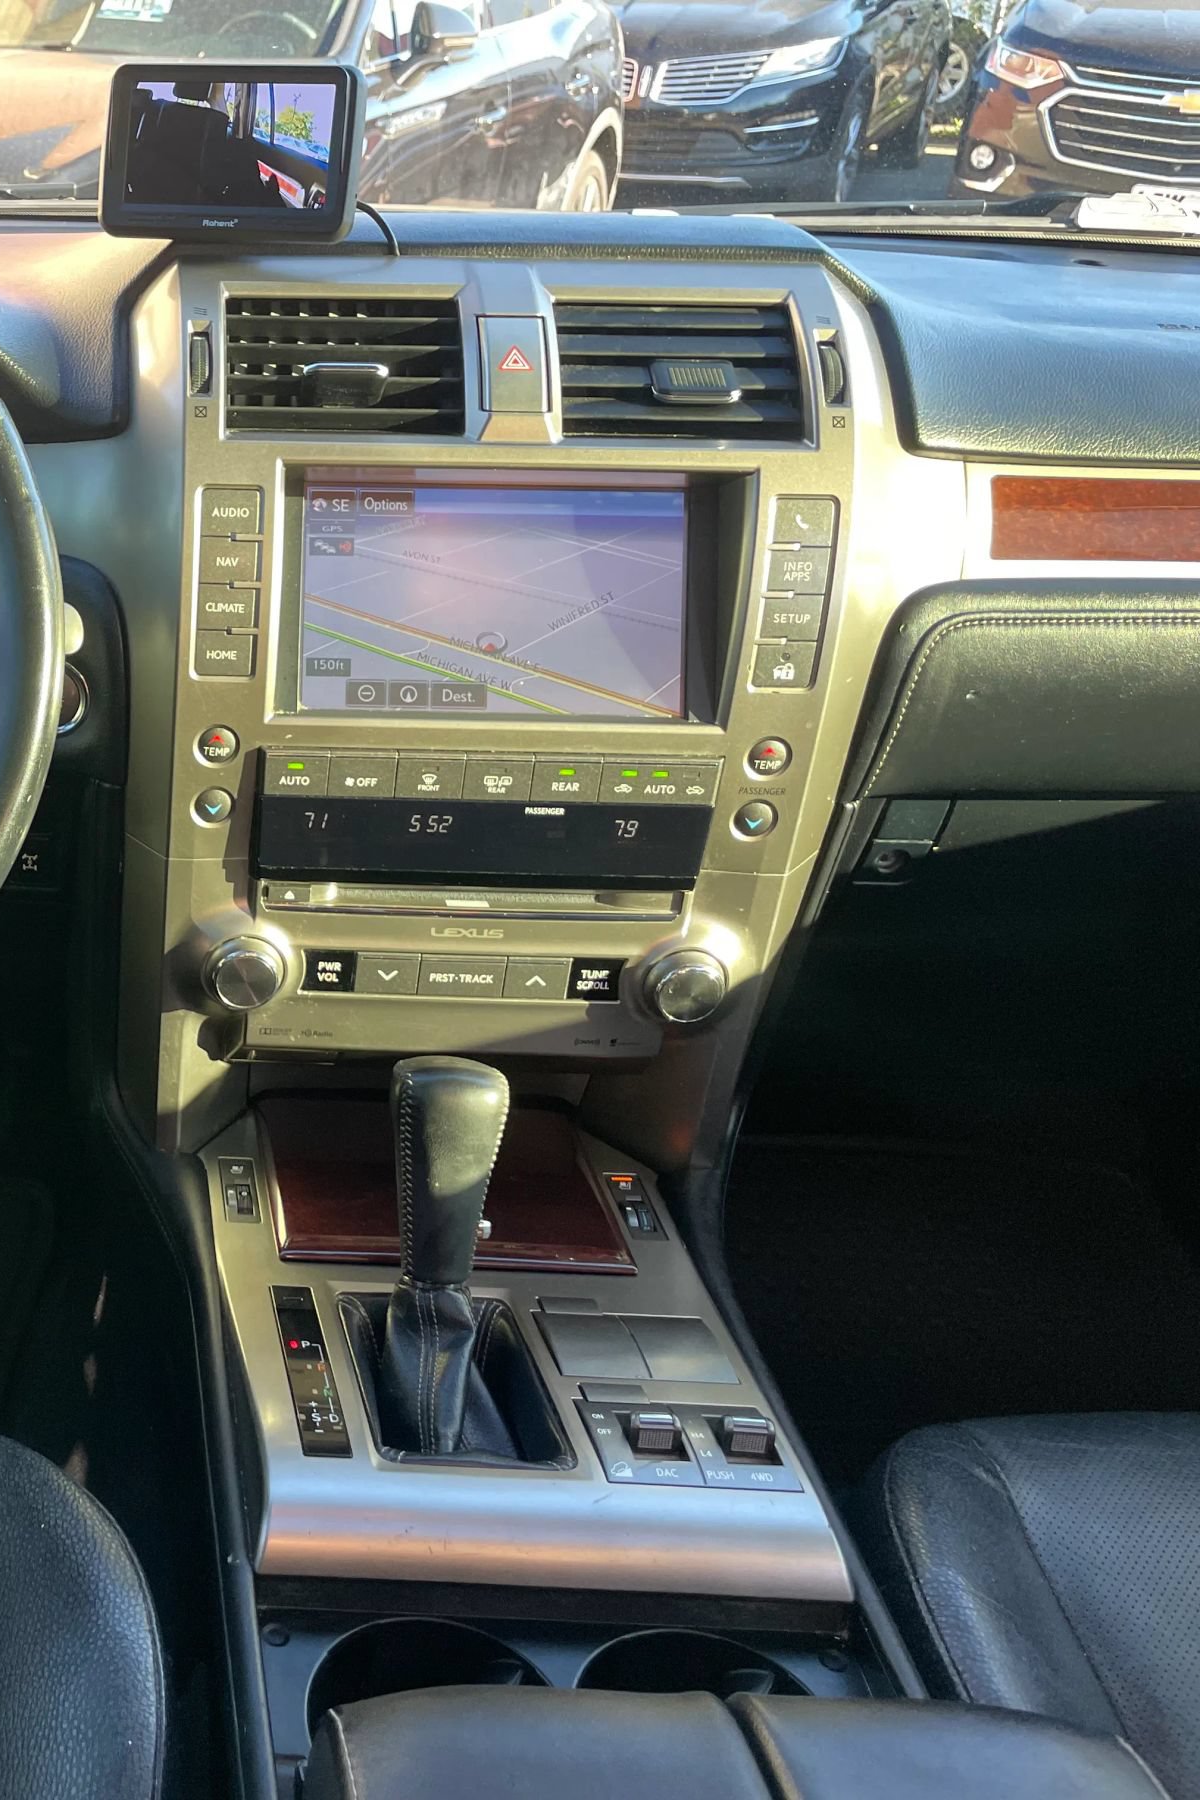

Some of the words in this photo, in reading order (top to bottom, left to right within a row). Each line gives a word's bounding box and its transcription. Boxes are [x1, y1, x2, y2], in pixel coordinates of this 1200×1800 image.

[332, 498, 350, 512] SE
[364, 497, 408, 513] Options
[212, 507, 250, 518] AUDIO
[402, 549, 429, 560] AVON
[216, 557, 239, 567] NAV
[784, 561, 813, 571] INFO
[784, 571, 810, 581] APPS
[205, 602, 245, 613] CLIMATE
[547, 599, 600, 632] WINIFRED
[600, 591, 615, 605] ST
[774, 613, 811, 623] SETUP
[206, 650, 237, 660] HOME
[313, 658, 344, 671] 150ft
[416, 652, 473, 678] MICHIGAN
[477, 672, 497, 686] AVE
[442, 688, 476, 703] Dest.
[203, 746, 230, 756] TEMP
[754, 760, 781, 769] TEMP
[279, 776, 310, 786] AUTO
[356, 777, 378, 787] OFF
[487, 785, 506, 793] REAR
[551, 781, 580, 792] REAR
[644, 784, 675, 795] AUTO
[738, 787, 786, 796] PASSENGER
[524, 806, 565, 816] PASSENGER
[304, 812, 329, 829] 71
[614, 820, 639, 838] 79
[430, 927, 504, 938] LEXUS
[318, 961, 341, 972] PWR
[317, 972, 339, 983] VOL
[581, 970, 610, 980] TUNE
[576, 980, 610, 991] SCROLL
[301, 1340, 310, 1348] P
[323, 1387, 333, 1396] N
[311, 1412, 321, 1422] S
[329, 1413, 339, 1422] D
[656, 1468, 678, 1478] DAC
[706, 1470, 735, 1480] PUSH
[750, 1472, 774, 1482] 4WD
